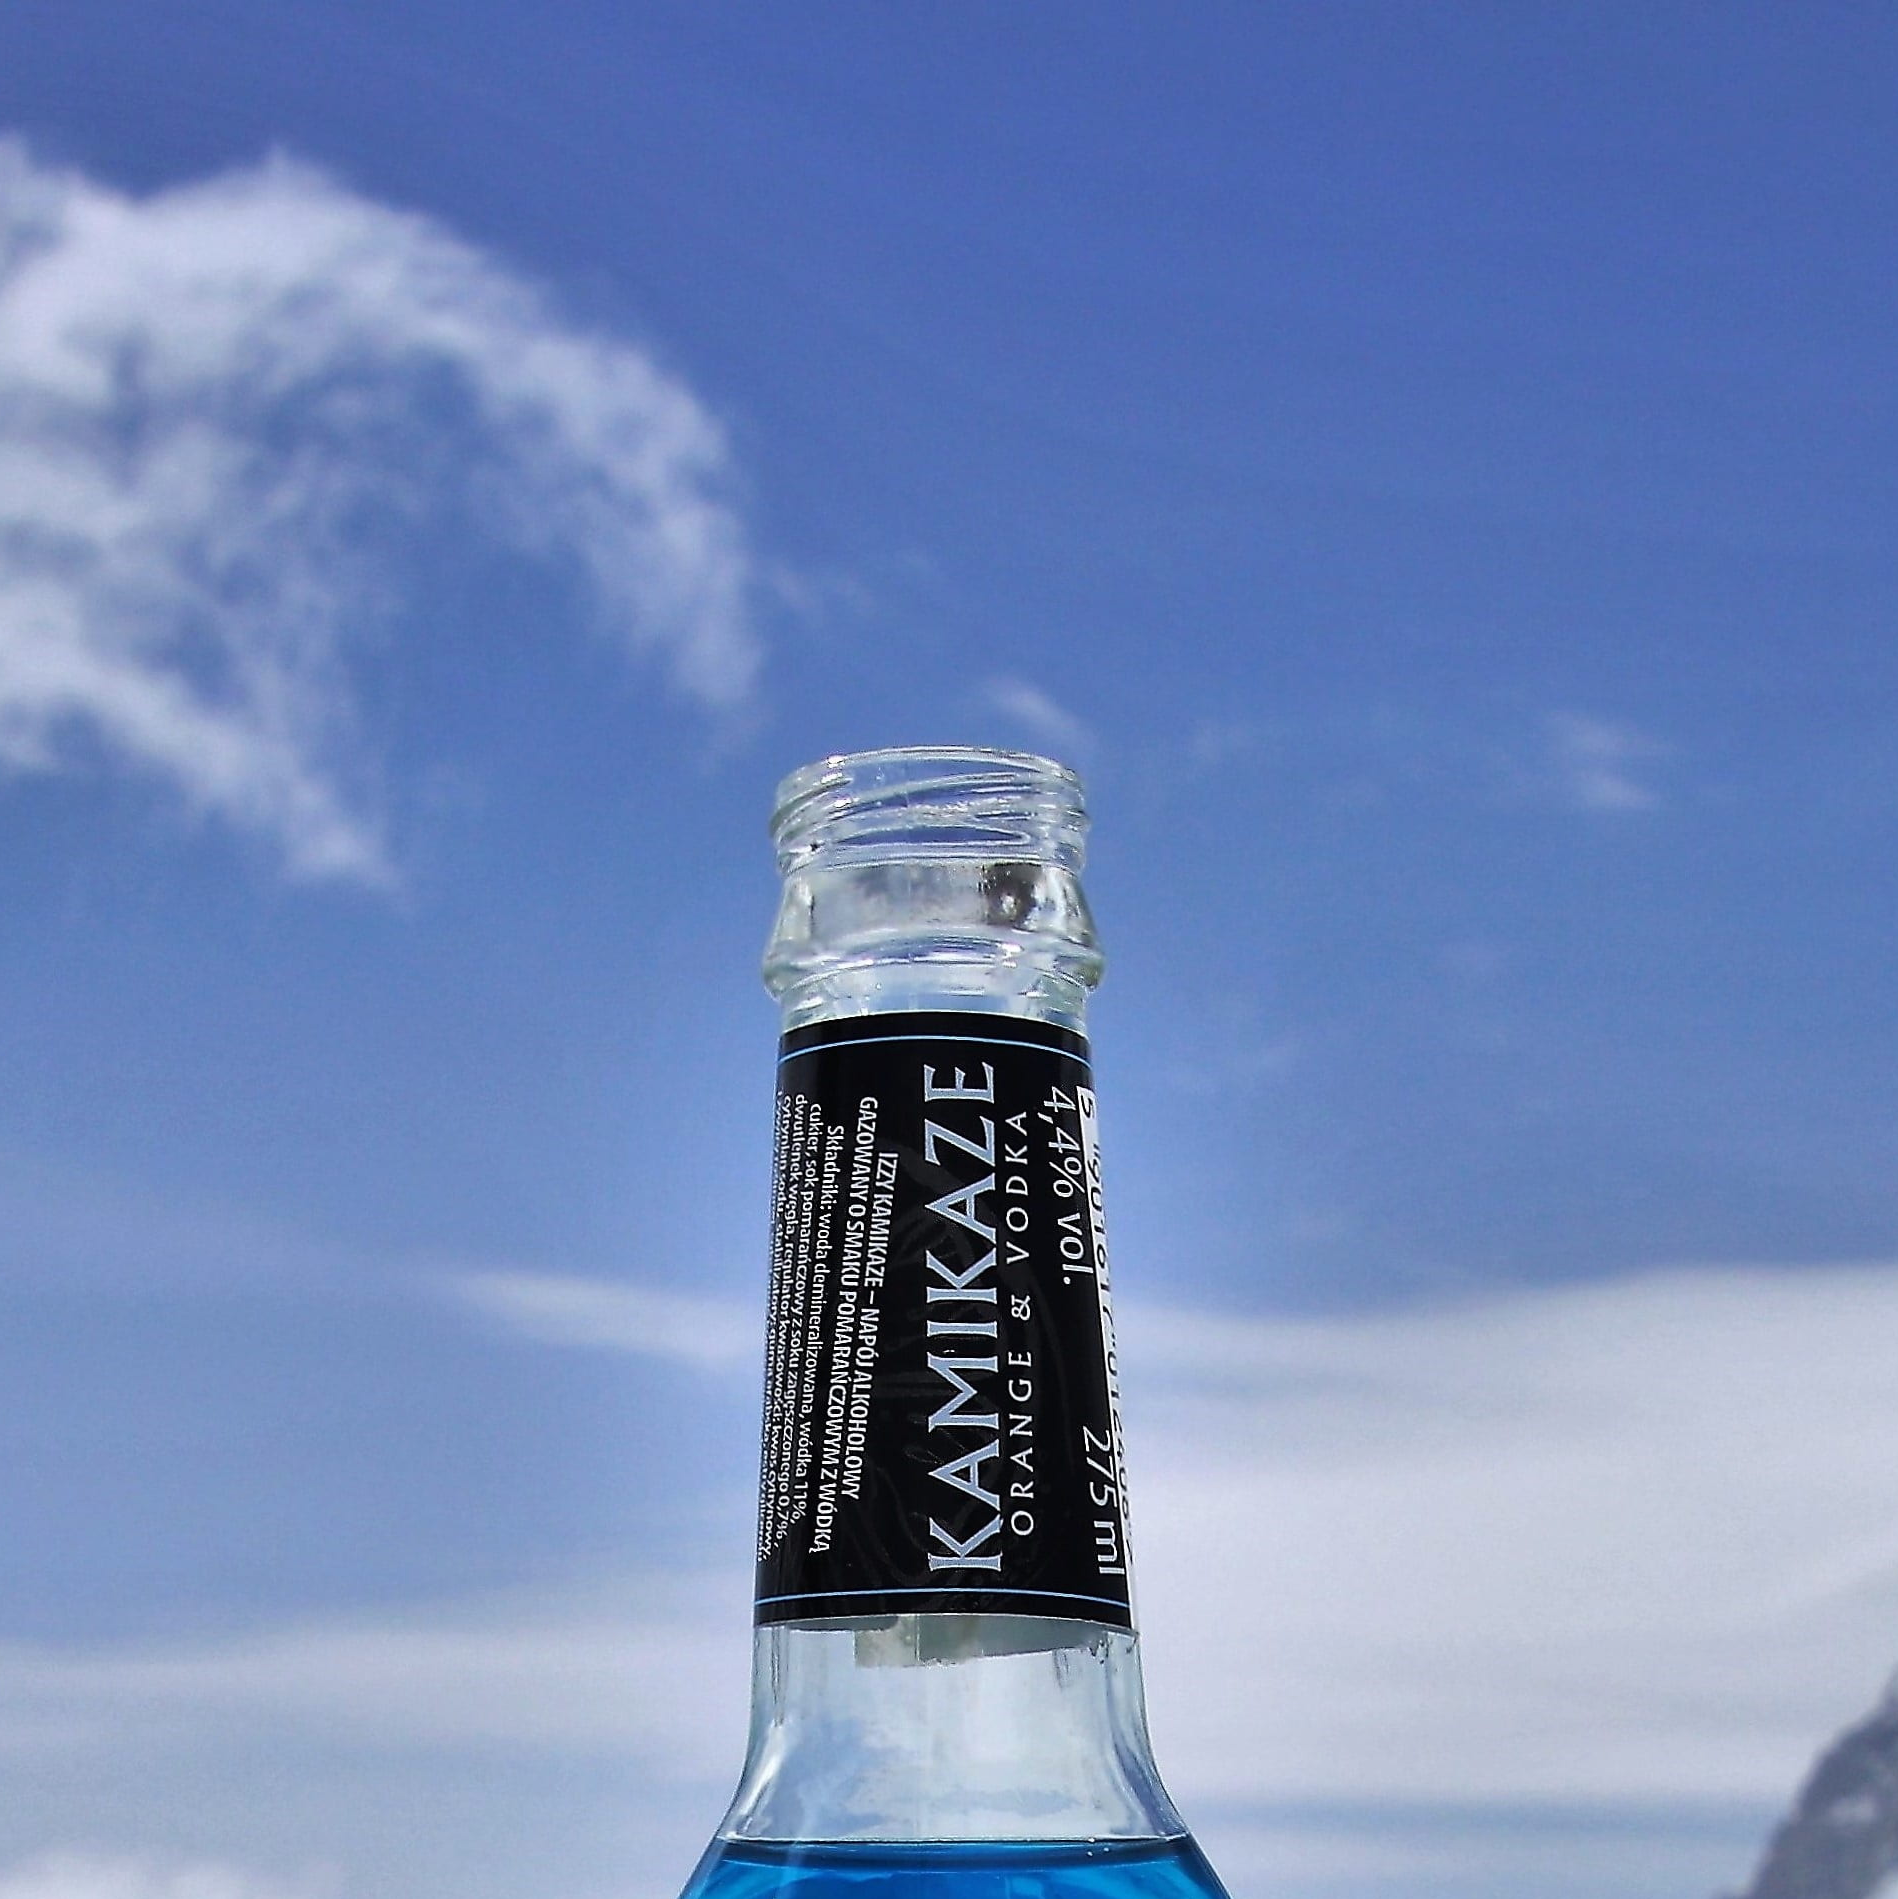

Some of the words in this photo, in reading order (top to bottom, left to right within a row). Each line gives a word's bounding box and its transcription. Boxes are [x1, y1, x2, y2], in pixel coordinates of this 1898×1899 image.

[804, 1103, 823, 1157] cukier,
[849, 1096, 878, 1202] GAZOWANY
[1038, 1085, 1085, 1197] 4,4%
[804, 1160, 819, 1187] sok
[820, 1124, 845, 1211] Składniki:
[875, 1152, 899, 1191] IZZY
[1004, 1110, 1032, 1264] VODKA
[814, 1213, 833, 1259] woda
[848, 1203, 866, 1217] O
[864, 1193, 893, 1288] KAMIKAZE
[840, 1220, 864, 1286] SMAKU
[1058, 1212, 1094, 1286] vol.
[798, 1263, 831, 1419] demineralizowana,
[855, 1308, 880, 1367] NAPÓJ
[923, 1061, 1004, 1573] KAMIKAZE
[1010, 1295, 1033, 1322] &
[789, 1329, 804, 1367] soku
[821, 1290, 857, 1465] POMARAŃCZOWYM
[795, 1421, 813, 1477] wódka
[841, 1370, 873, 1500] ALKOHOLOWY
[1006, 1349, 1036, 1536] ORANGE
[1082, 1425, 1117, 1508] 275
[790, 1481, 809, 1525] 11%,
[820, 1467, 838, 1480] Z
[809, 1482, 838, 1554] WÓDKĄ
[1093, 1520, 1125, 1574] ml
